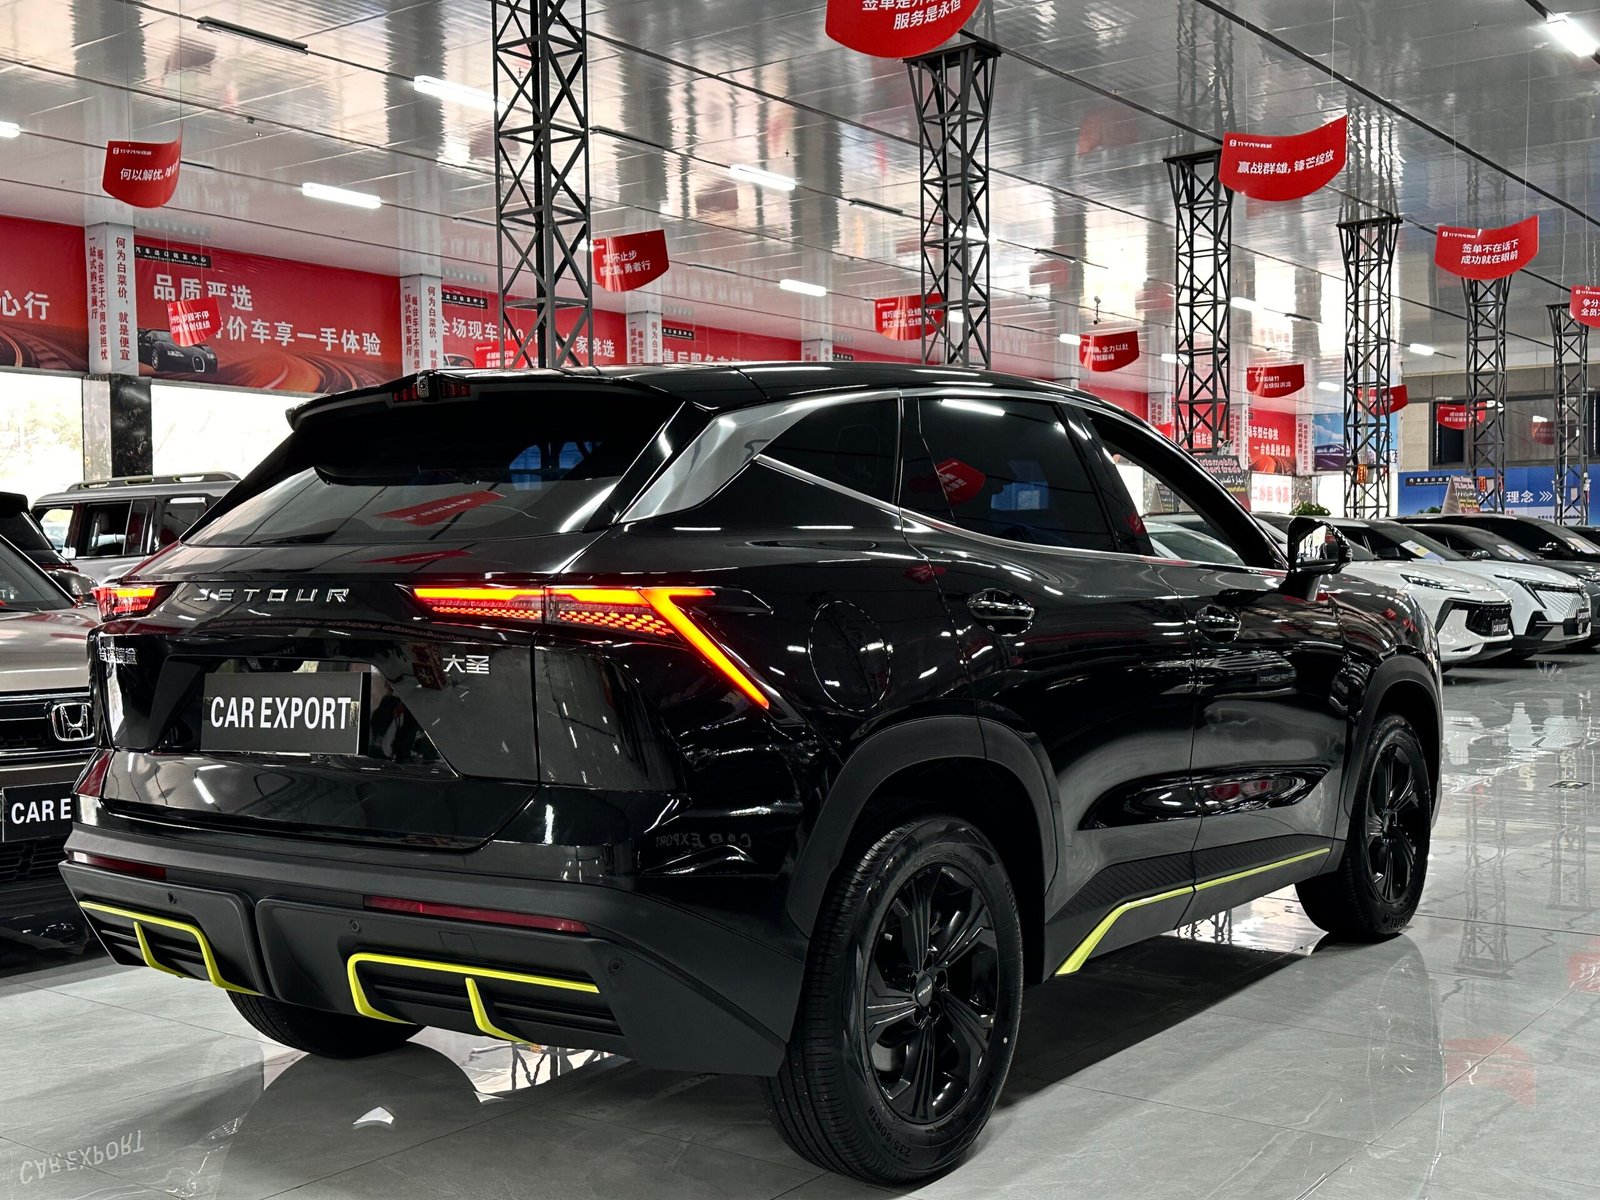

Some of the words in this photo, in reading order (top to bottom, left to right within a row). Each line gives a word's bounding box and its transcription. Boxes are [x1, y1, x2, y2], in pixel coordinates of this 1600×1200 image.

[1462, 238, 1519, 254] 签单不在话下
[1460, 250, 1519, 265] 成功就在眼前
[193, 588, 350, 603] JETOUR
[442, 654, 490, 674] 大圣
[210, 696, 255, 728] CAR
[259, 696, 352, 729] EXPORT
[10, 799, 55, 825] CAR
